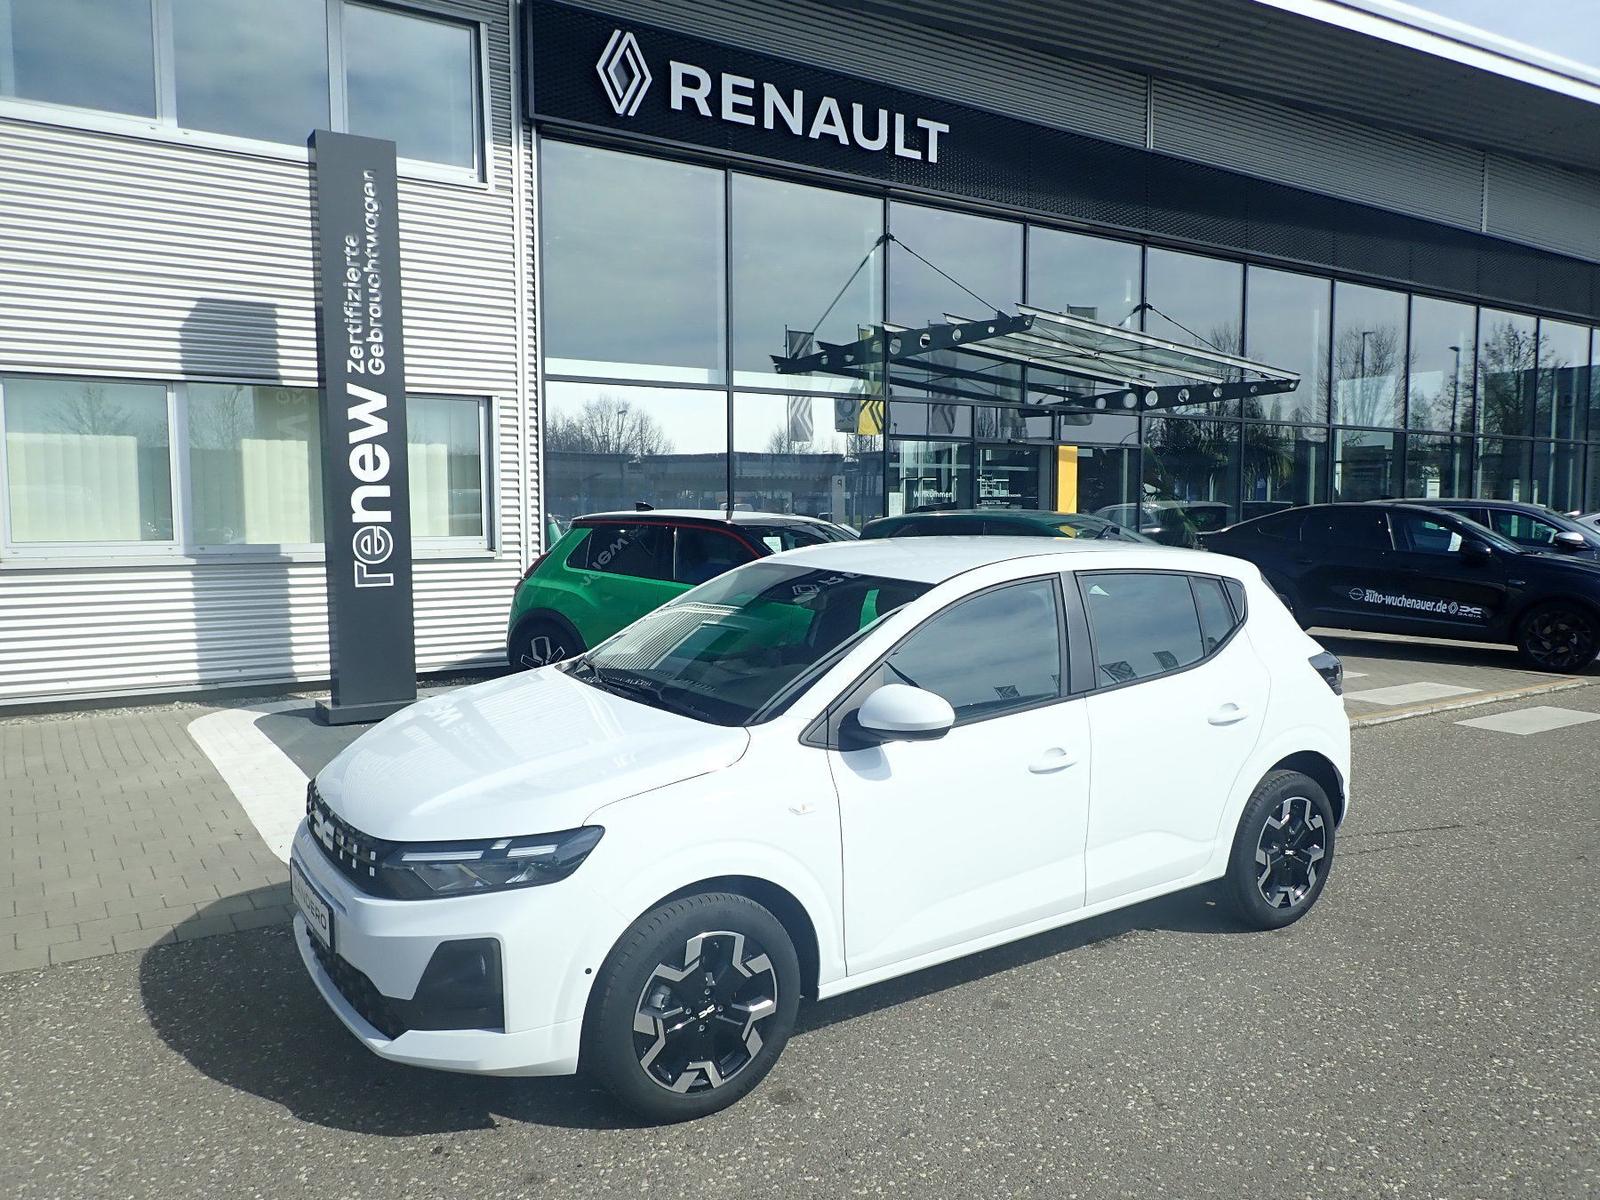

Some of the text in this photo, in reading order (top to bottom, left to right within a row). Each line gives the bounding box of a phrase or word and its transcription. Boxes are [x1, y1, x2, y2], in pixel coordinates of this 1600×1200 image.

[669, 60, 950, 163] RENAULT
[343, 232, 365, 374] Zertifizierte
[363, 168, 386, 376] Gebrauchtwagen
[346, 382, 394, 588] renew
